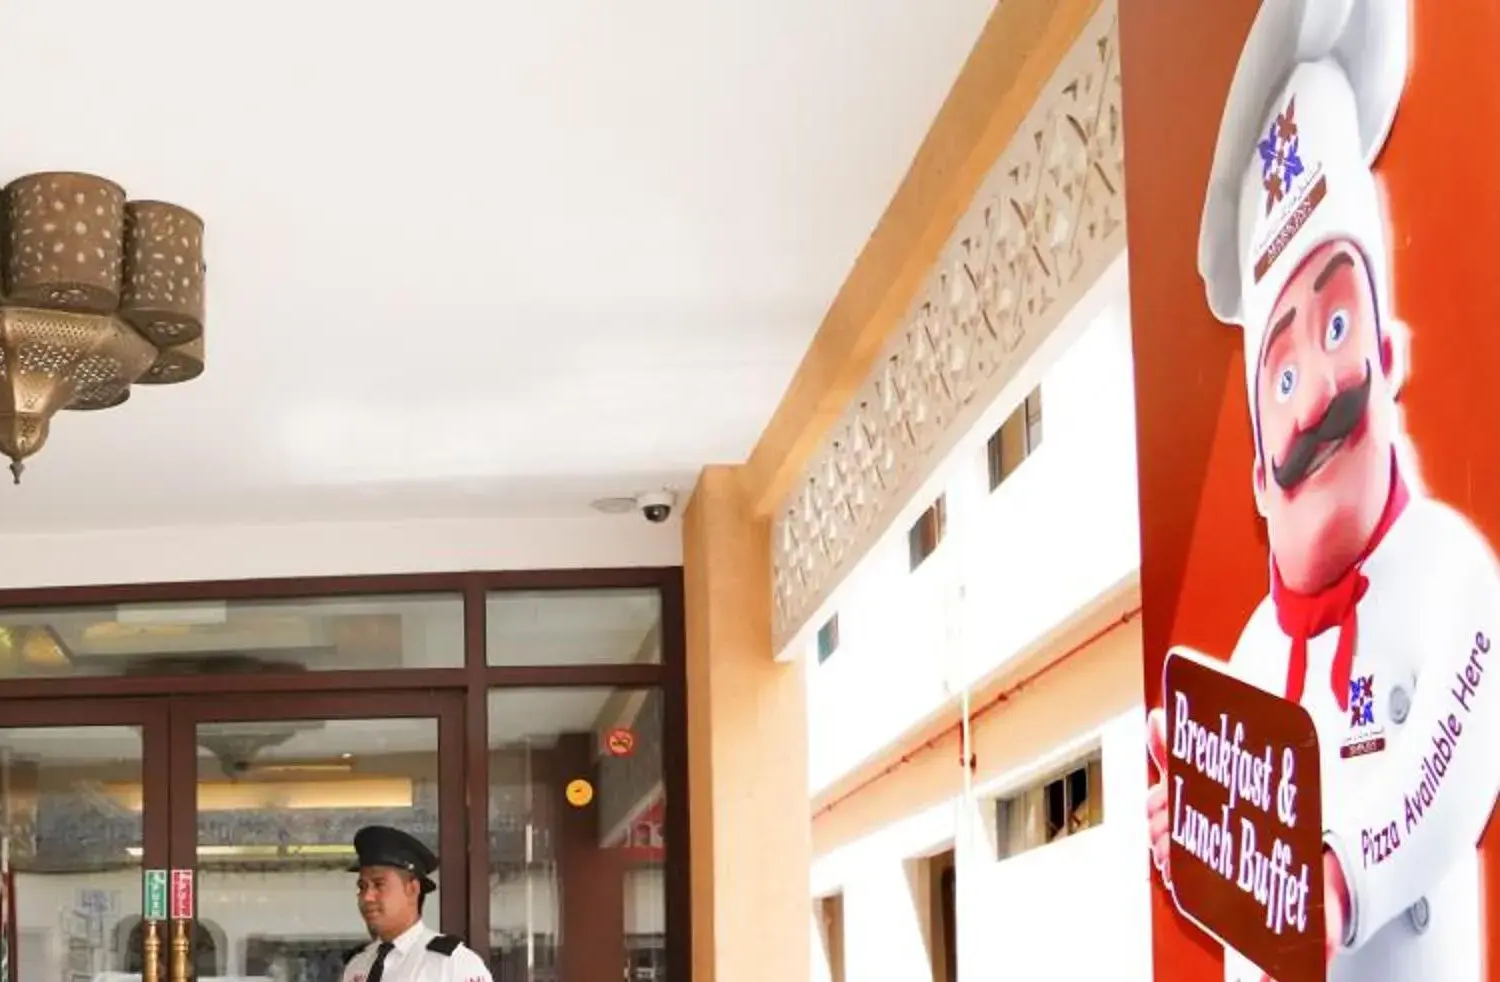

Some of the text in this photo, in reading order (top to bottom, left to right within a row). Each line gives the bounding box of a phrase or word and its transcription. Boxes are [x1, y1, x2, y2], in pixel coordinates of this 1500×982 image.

[1172, 691, 1298, 829] Breakfast &
[1361, 631, 1491, 869] Pizza Available Here
[1171, 774, 1309, 935] Lunch Buffet
